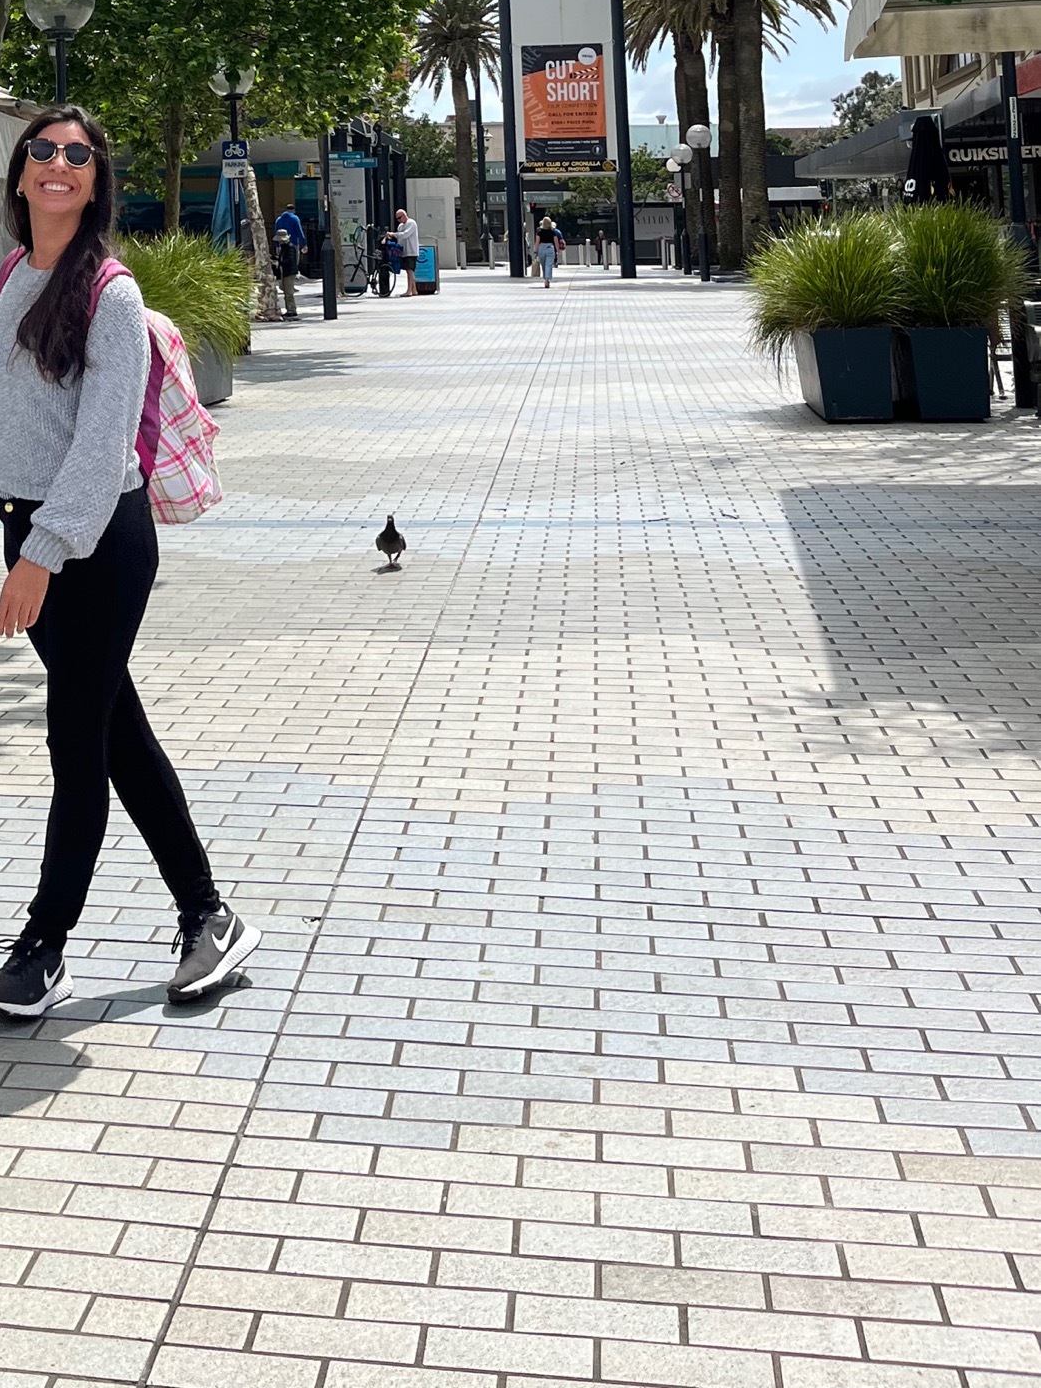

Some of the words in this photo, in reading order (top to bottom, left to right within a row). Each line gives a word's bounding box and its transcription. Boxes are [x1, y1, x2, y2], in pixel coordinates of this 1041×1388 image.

[545, 60, 576, 80] CUT
[546, 81, 600, 102] SHORT
[948, 145, 1041, 162] QUIKSIER
